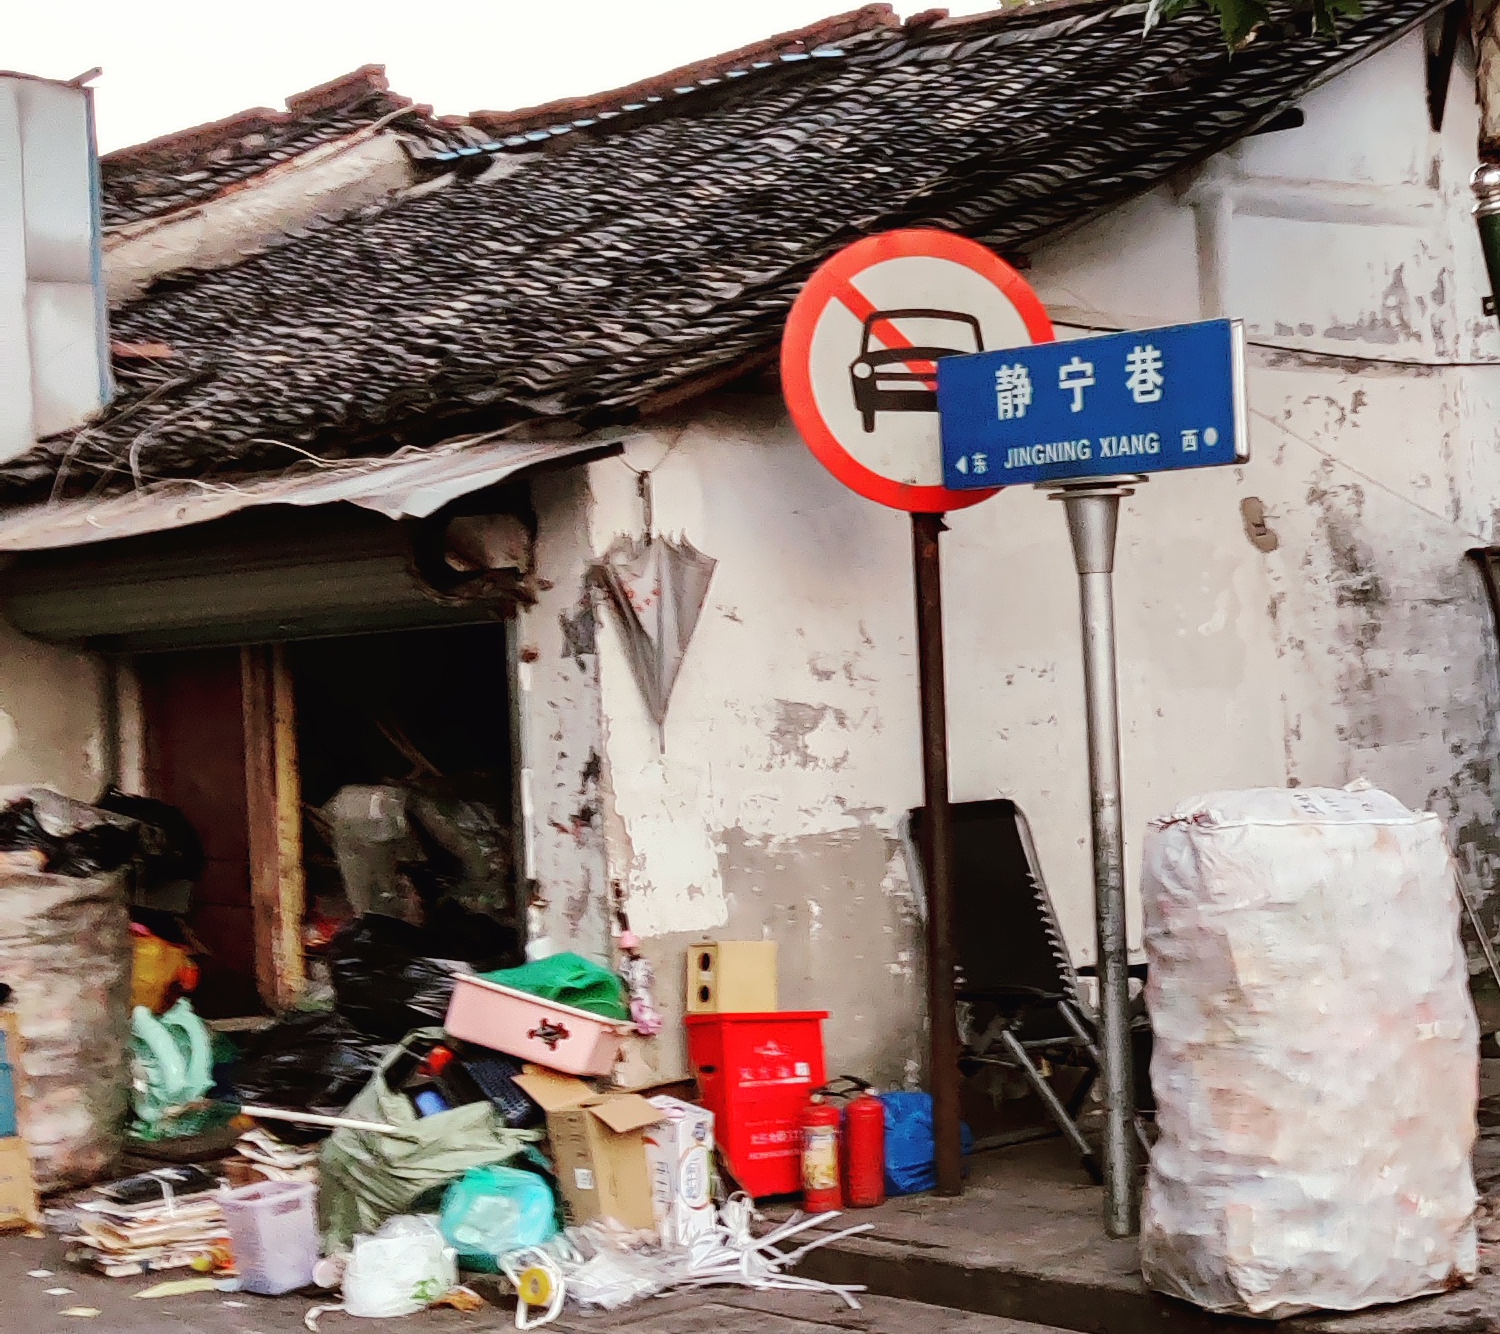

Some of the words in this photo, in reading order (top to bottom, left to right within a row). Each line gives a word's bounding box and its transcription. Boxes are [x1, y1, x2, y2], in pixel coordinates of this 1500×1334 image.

[995, 344, 1164, 420] 静宁巷
[1004, 438, 1092, 469] JINGNING
[1099, 432, 1161, 459] XIANG
[1180, 429, 1199, 453] 西
[971, 452, 989, 475] 东
